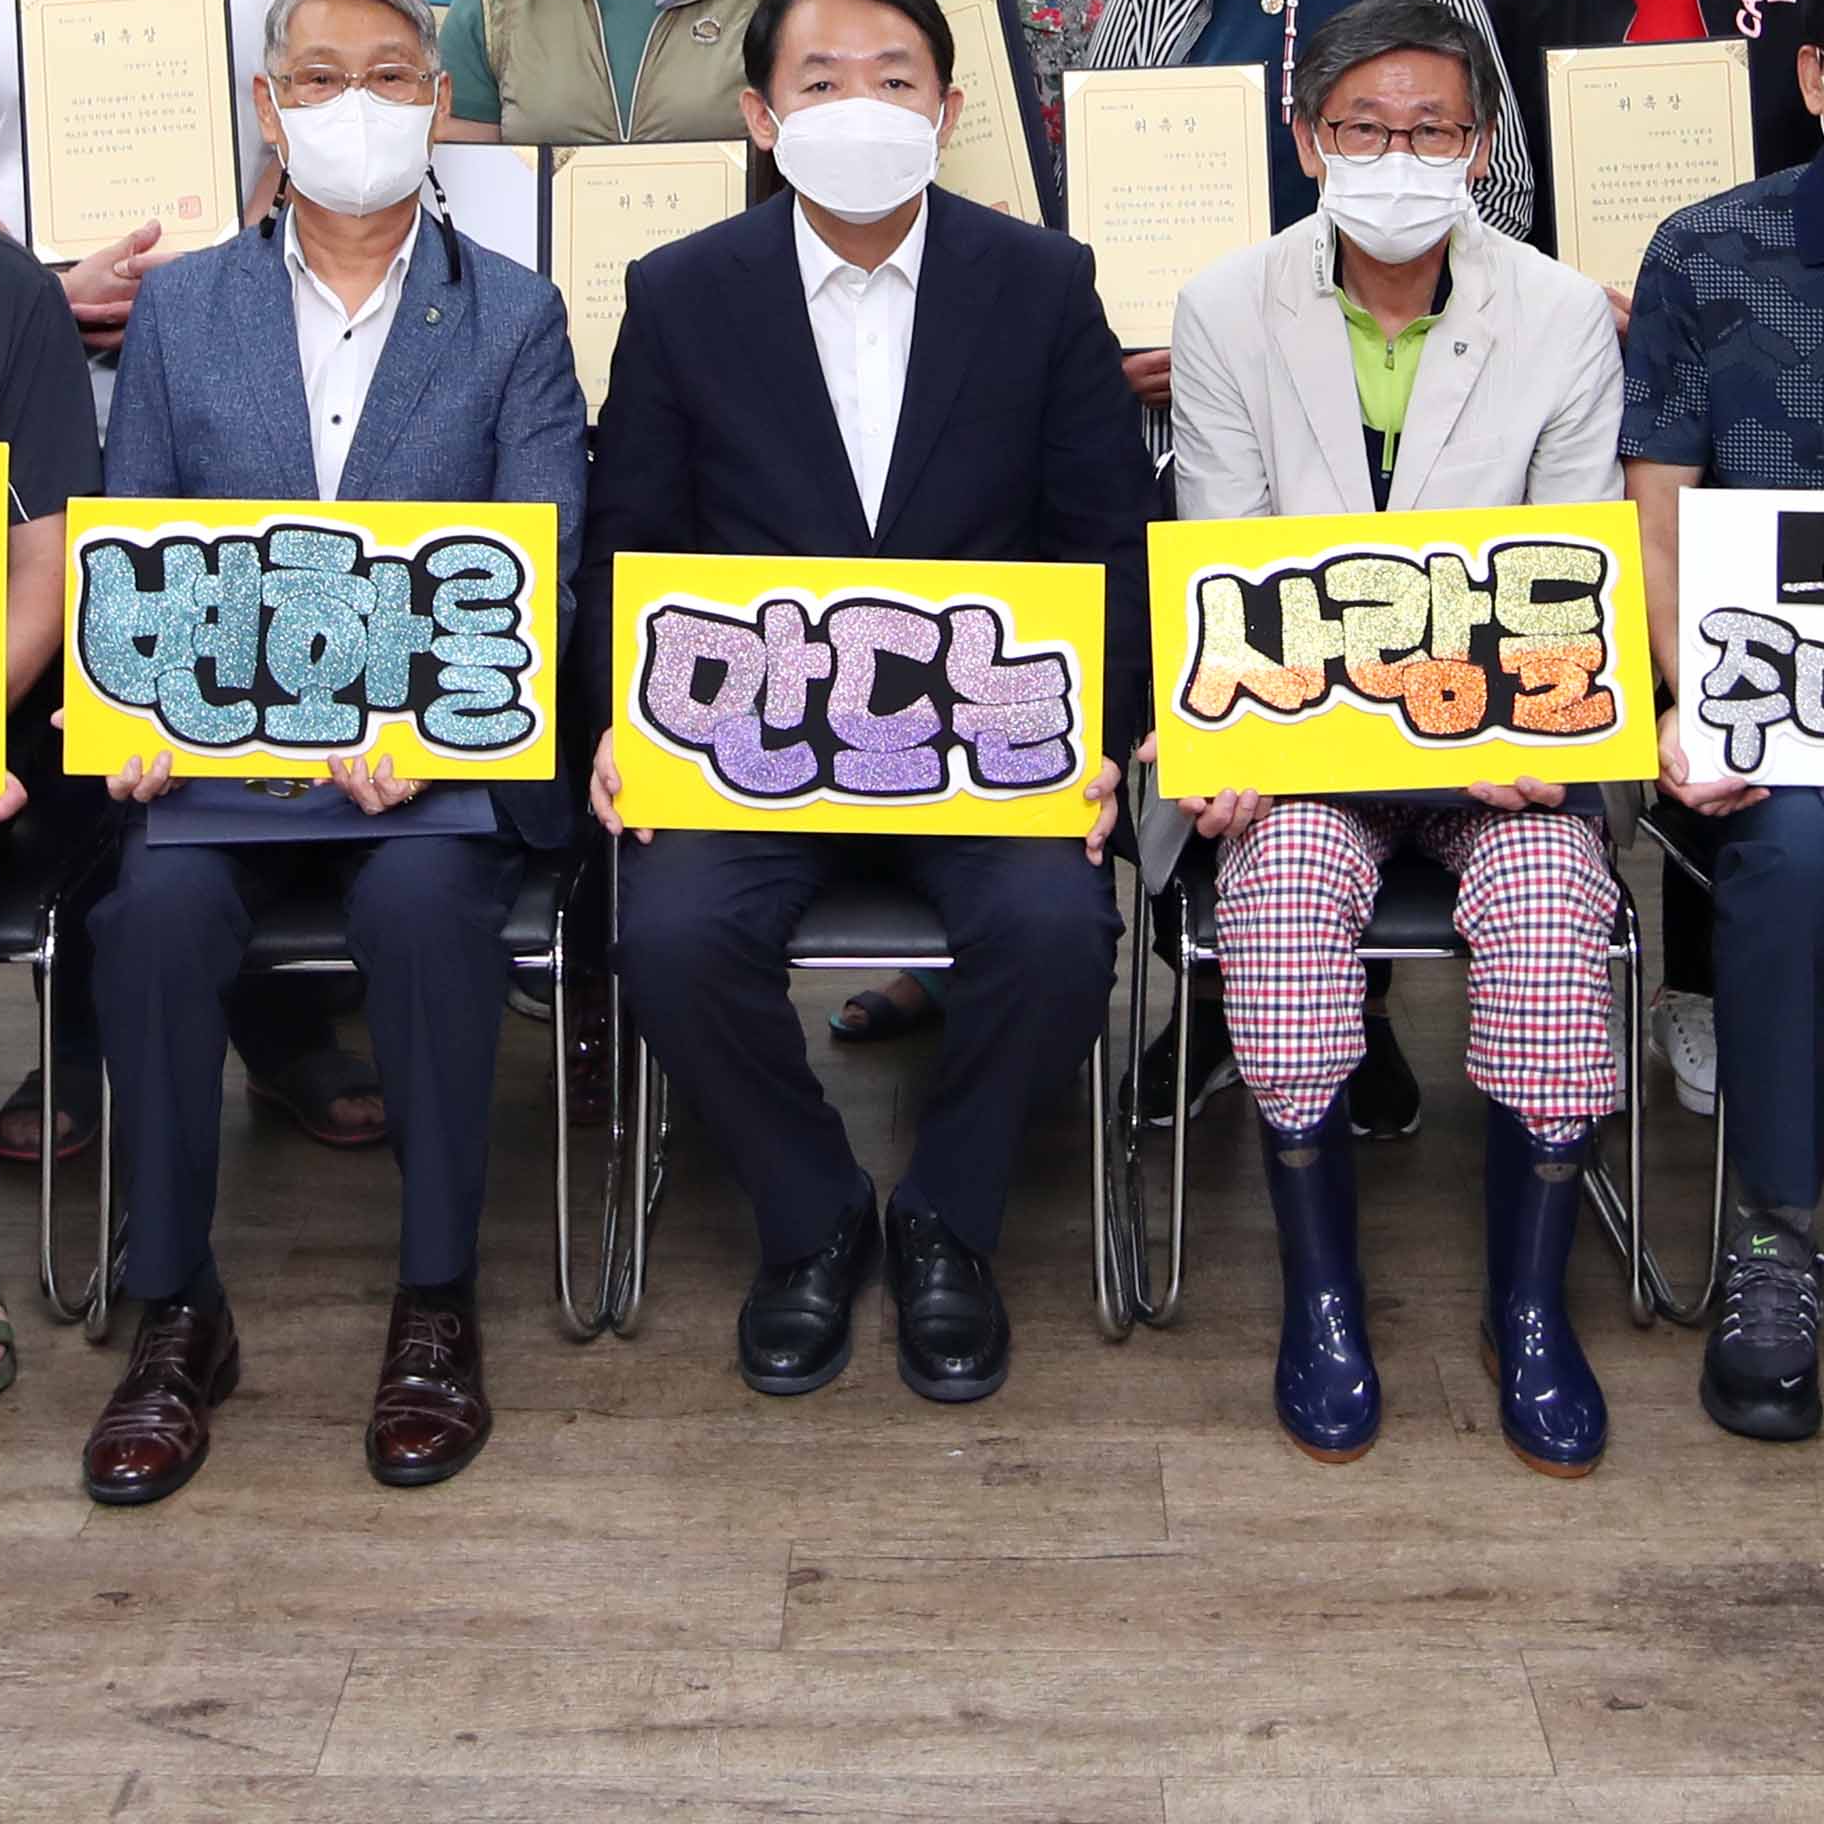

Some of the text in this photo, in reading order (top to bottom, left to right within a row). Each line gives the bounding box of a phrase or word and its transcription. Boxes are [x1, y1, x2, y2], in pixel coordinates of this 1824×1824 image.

[78, 524, 536, 751] 변화를
[639, 597, 1077, 797] 만드는
[1181, 541, 1618, 739] 사람들
